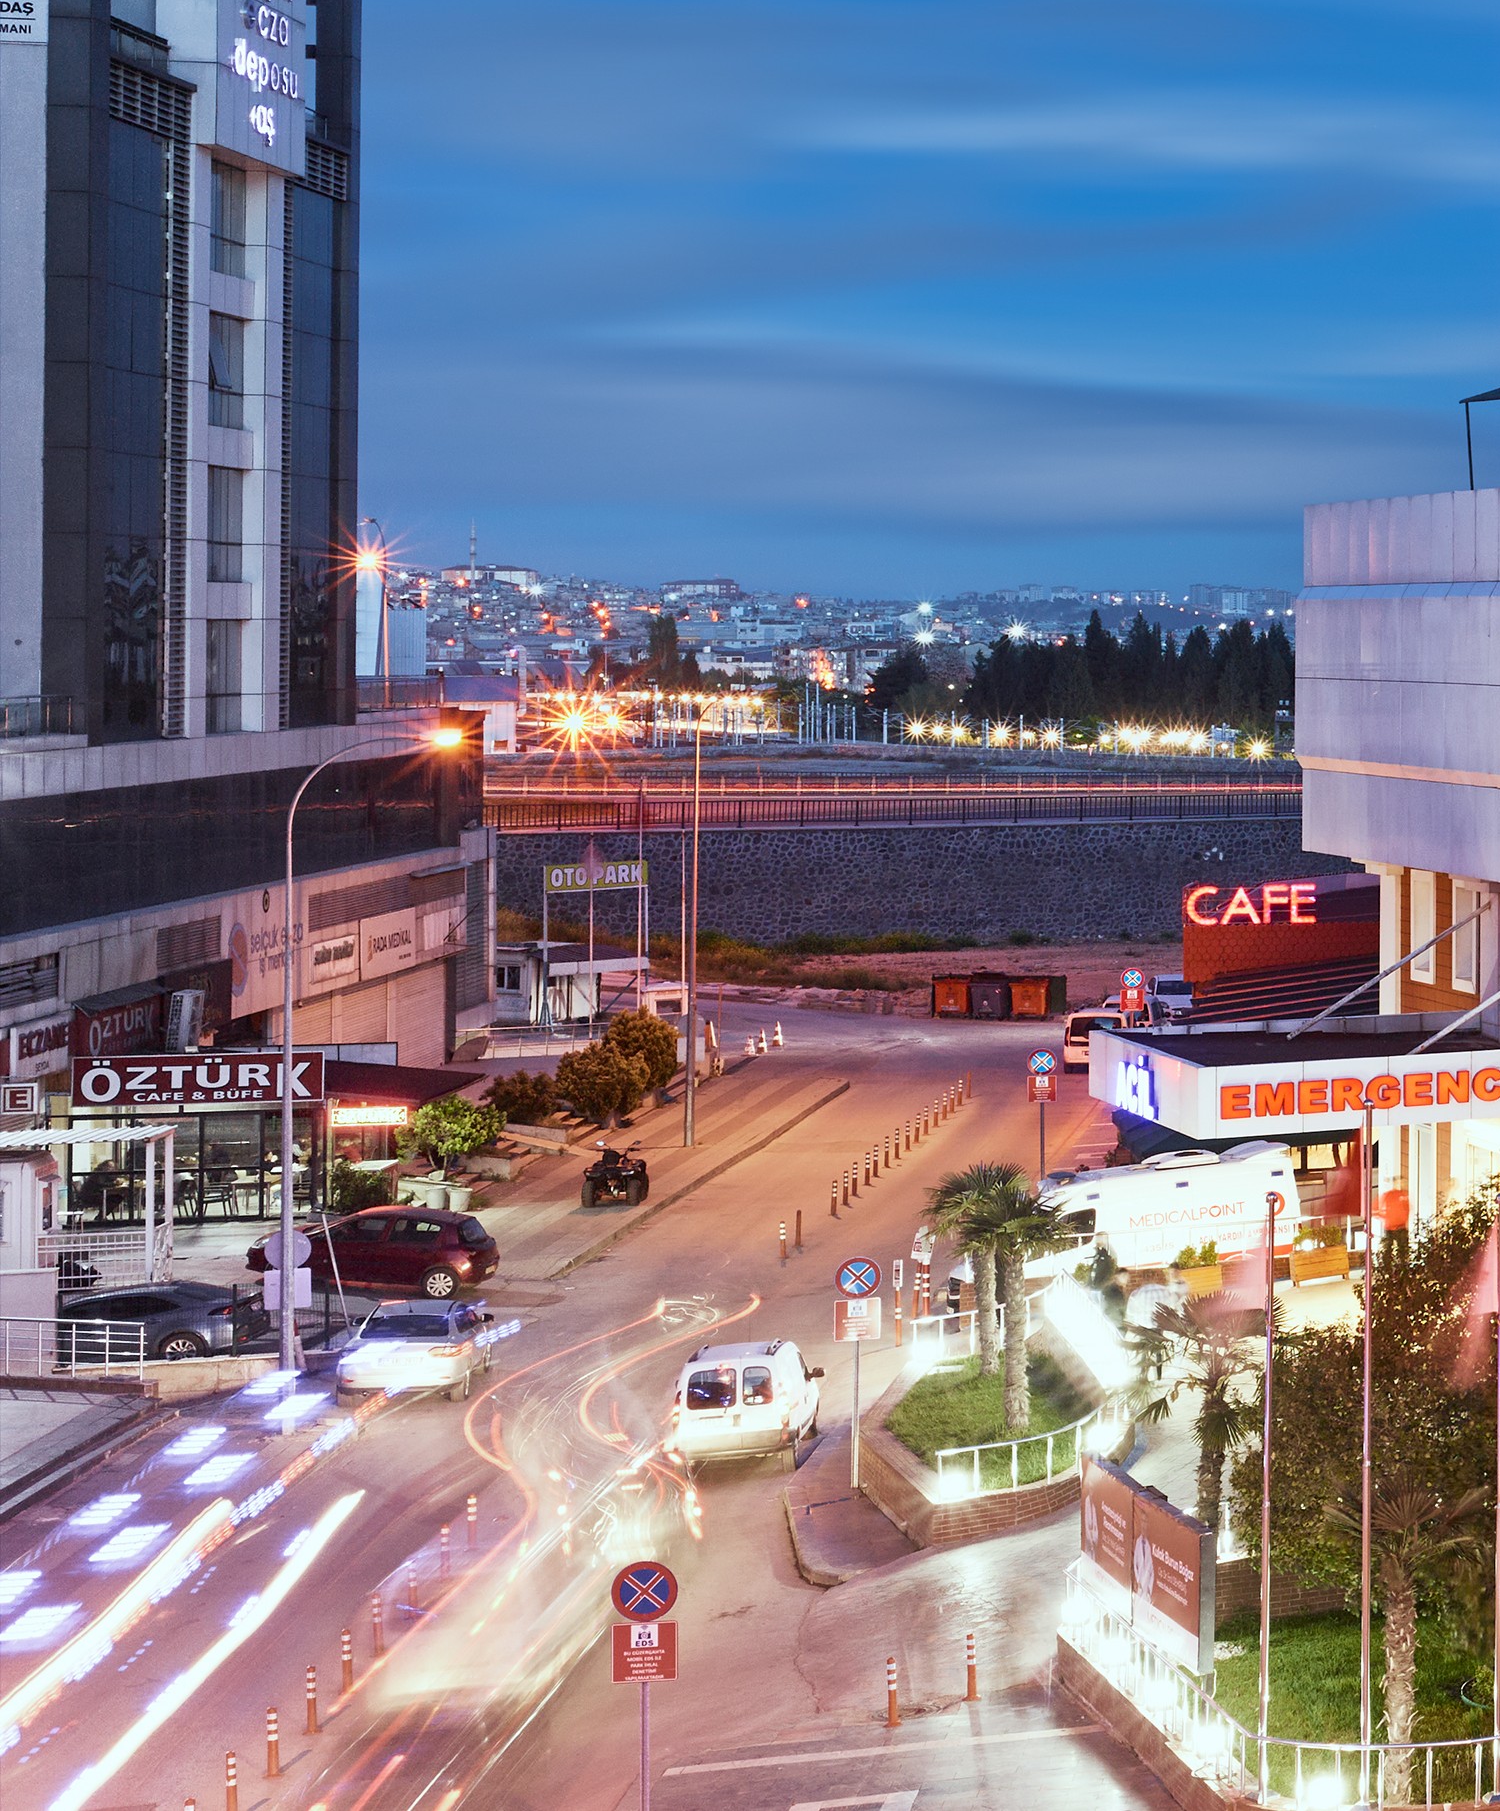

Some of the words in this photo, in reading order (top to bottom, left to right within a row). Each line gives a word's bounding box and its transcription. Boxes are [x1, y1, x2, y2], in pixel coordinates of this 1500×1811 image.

[551, 867, 588, 887] OTO
[592, 864, 642, 885] PARK
[1186, 883, 1318, 926] CAFE
[18, 1021, 69, 1061] ECZANE
[80, 1057, 312, 1103] ÖZTÜRK
[133, 1092, 184, 1102] CAFE
[191, 1091, 205, 1101] &
[213, 1088, 263, 1100] BÜFE
[1129, 1201, 1245, 1228] MEDICALPOINT
